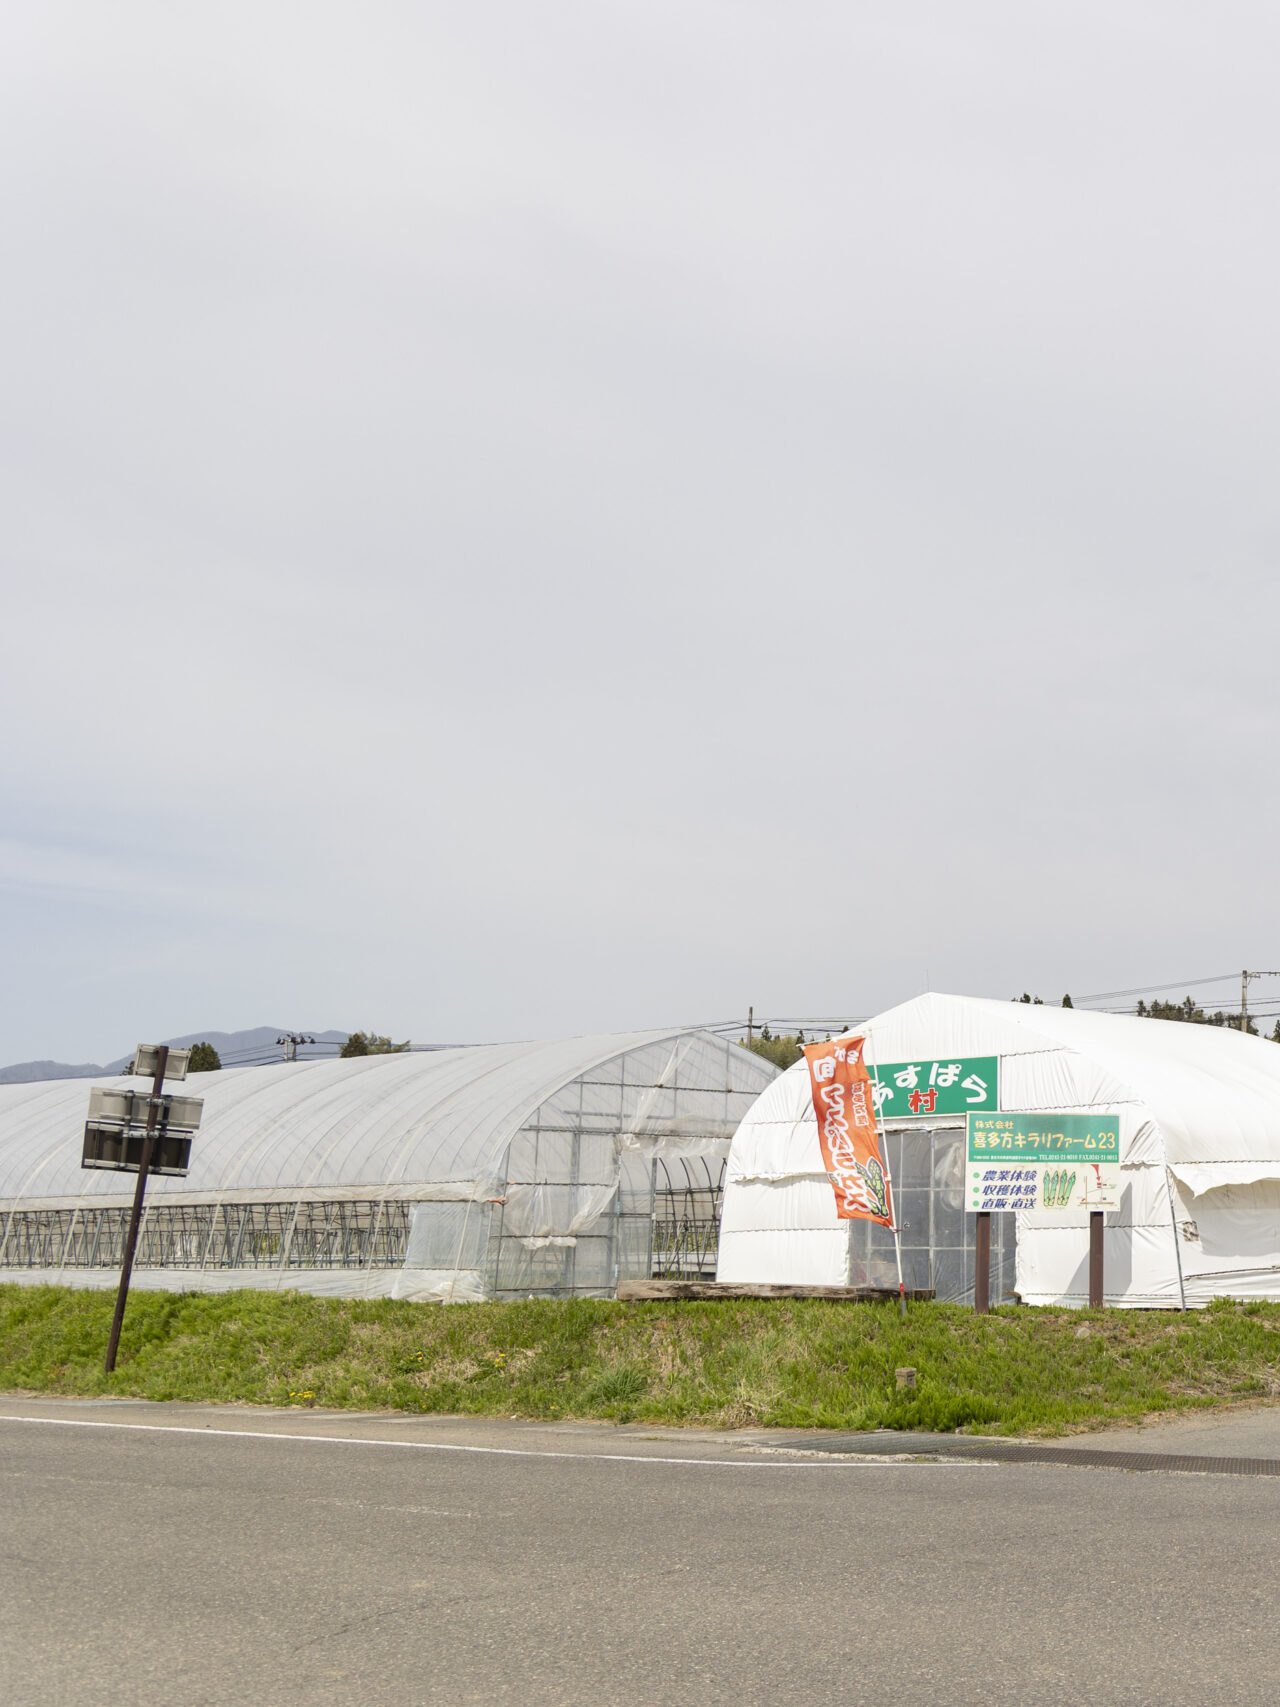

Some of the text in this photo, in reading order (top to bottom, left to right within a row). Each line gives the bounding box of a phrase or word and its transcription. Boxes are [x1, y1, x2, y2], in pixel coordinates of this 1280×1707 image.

[908, 1088, 938, 1113] 村
[975, 1120, 1014, 1130] 株式会社
[973, 1131, 1116, 1149] 喜多方キラリファーム23
[982, 1170, 1038, 1181] 農業体験
[982, 1184, 1038, 1196] 収穫体験
